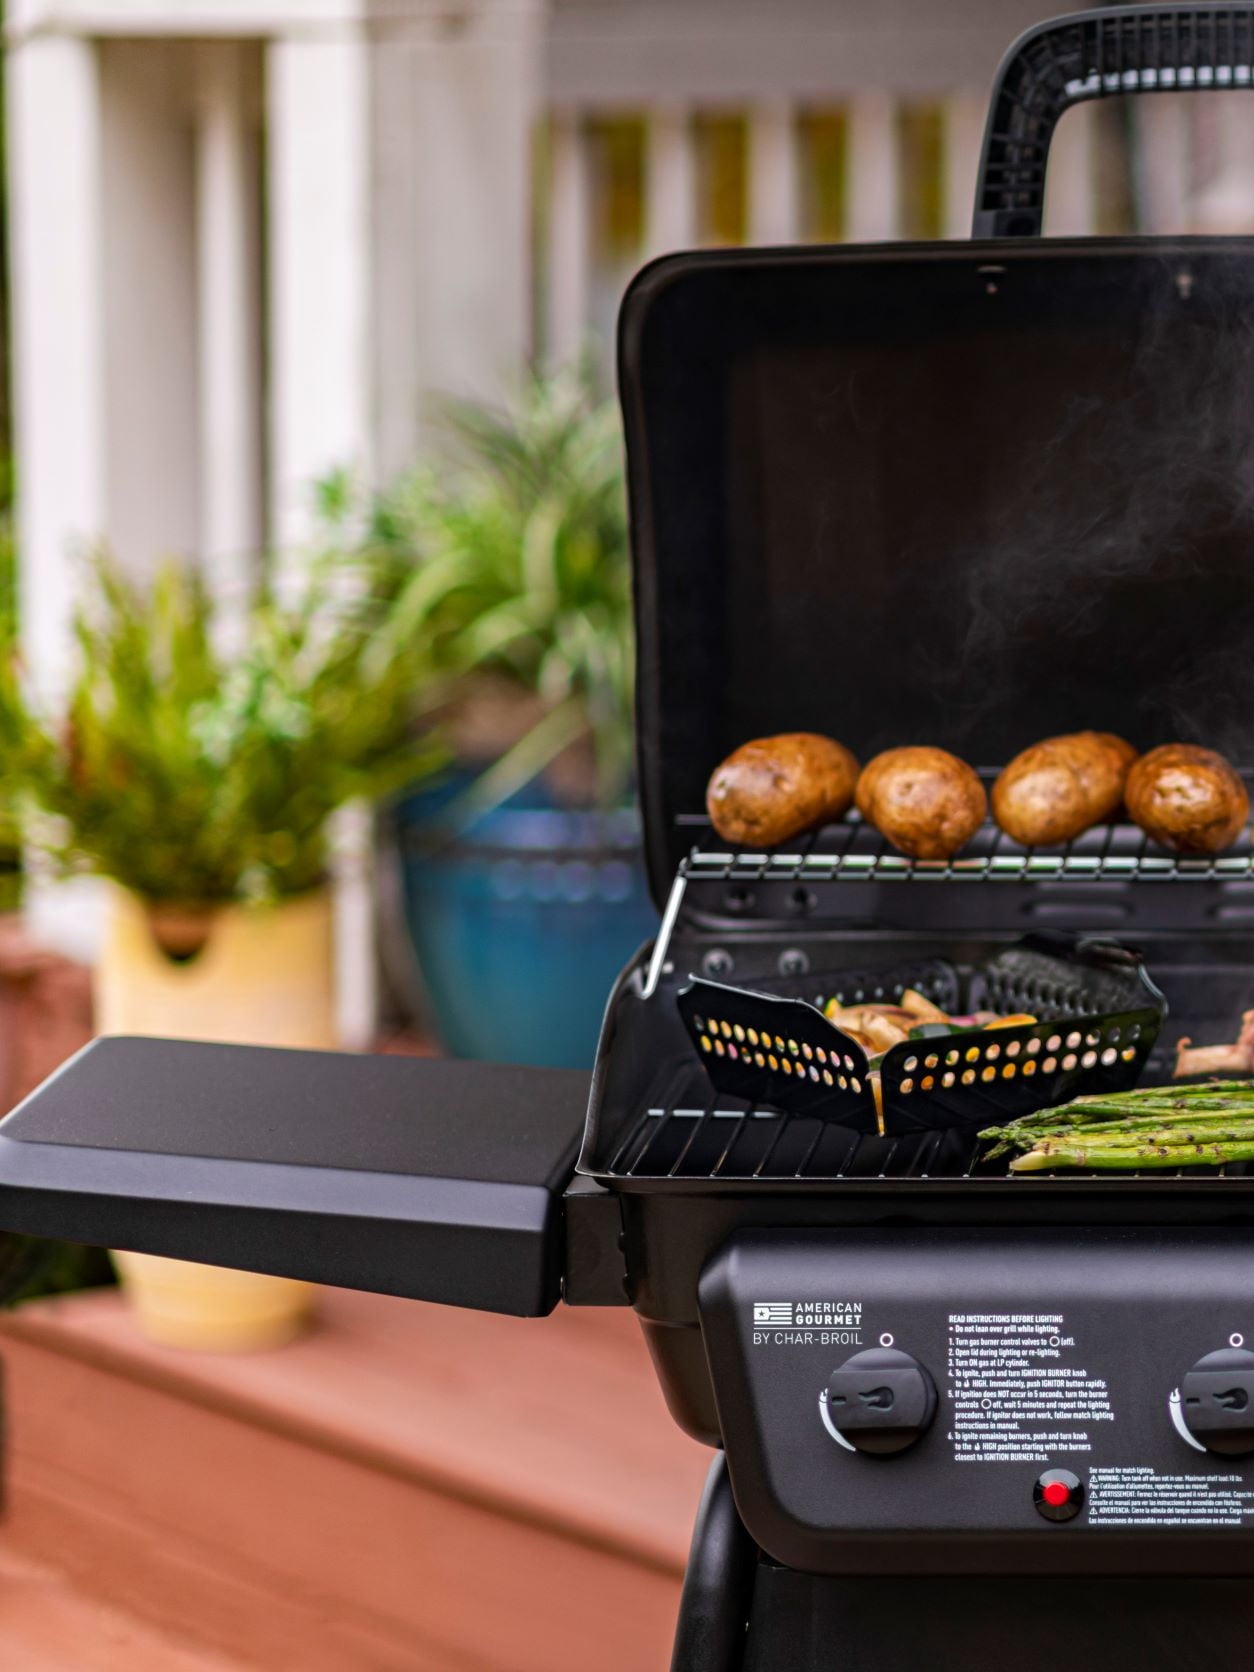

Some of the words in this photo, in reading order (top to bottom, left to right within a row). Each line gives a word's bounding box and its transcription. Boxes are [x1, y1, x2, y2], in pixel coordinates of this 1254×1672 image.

[796, 1302, 862, 1313] AMERICAN
[796, 1314, 862, 1325] GOURMET
[948, 1315, 966, 1323] READ
[966, 1315, 1011, 1323] INSTRUCTIONS
[1011, 1315, 1034, 1323] BEFORE
[1035, 1315, 1063, 1323] LIGHTING
[955, 1325, 964, 1333] Do
[964, 1325, 975, 1333] not
[975, 1325, 989, 1333] lean
[1003, 1325, 1017, 1335] grill
[1017, 1325, 1034, 1333] while
[753, 1332, 770, 1344] BY
[774, 1332, 863, 1344] CHAR-BROIL
[955, 1338, 969, 1346] Turn
[969, 1340, 980, 1348] gas
[980, 1338, 1000, 1346] burner
[1000, 1338, 1021, 1346] control
[1021, 1338, 1040, 1346] valves
[955, 1348, 970, 1359] Open
[979, 1348, 998, 1359] during
[998, 1348, 1021, 1359] lighting
[955, 1359, 968, 1367] Turn
[969, 1359, 978, 1367] ON
[978, 1361, 989, 1369] gas
[981, 1369, 996, 1379] push
[996, 1369, 1008, 1377] and
[1008, 1369, 1021, 1377] turn
[1021, 1369, 1047, 1377] IGNITION
[1047, 1369, 1071, 1377] BURNER
[1072, 1369, 1087, 1377] knob
[1026, 1380, 1041, 1390] push
[1041, 1380, 1065, 1388] IGNITOR
[1065, 1380, 1085, 1388] button
[960, 1390, 982, 1400] ignition
[983, 1390, 997, 1398] does
[997, 1390, 1009, 1398] NOT
[1065, 1390, 1078, 1398] turn
[1078, 1390, 1088, 1398] the
[1088, 1390, 1108, 1398] burner
[955, 1401, 979, 1409] controls
[1003, 1401, 1016, 1409] wait
[1022, 1401, 1046, 1409] minutes
[1046, 1401, 1057, 1409] and
[1057, 1401, 1076, 1411] repeat
[1077, 1401, 1087, 1409] the
[1087, 1401, 1110, 1411] lighting
[992, 1411, 1011, 1422] ignitor
[1011, 1411, 1026, 1420] does
[1026, 1411, 1036, 1420] not
[1054, 1411, 1072, 1420] follow
[1072, 1411, 1091, 1420] match
[1091, 1411, 1114, 1422] lighting
[955, 1422, 989, 1430] instructions
[962, 1432, 978, 1442] ignite
[979, 1432, 1008, 1442] remaining
[1033, 1432, 1048, 1442] push
[1048, 1432, 1059, 1440] and
[1059, 1432, 1072, 1440] turn
[1072, 1432, 1088, 1440] knob
[962, 1443, 972, 1451] the
[982, 1443, 997, 1451] HIGH
[997, 1443, 1021, 1453] position
[1021, 1443, 1044, 1453] starting
[1044, 1443, 1058, 1451] with
[1058, 1443, 1068, 1451] the
[1068, 1443, 1091, 1451] burners
[954, 1453, 976, 1461] closest
[984, 1453, 1010, 1461] IGNITION
[1010, 1453, 1034, 1461] BURNER
